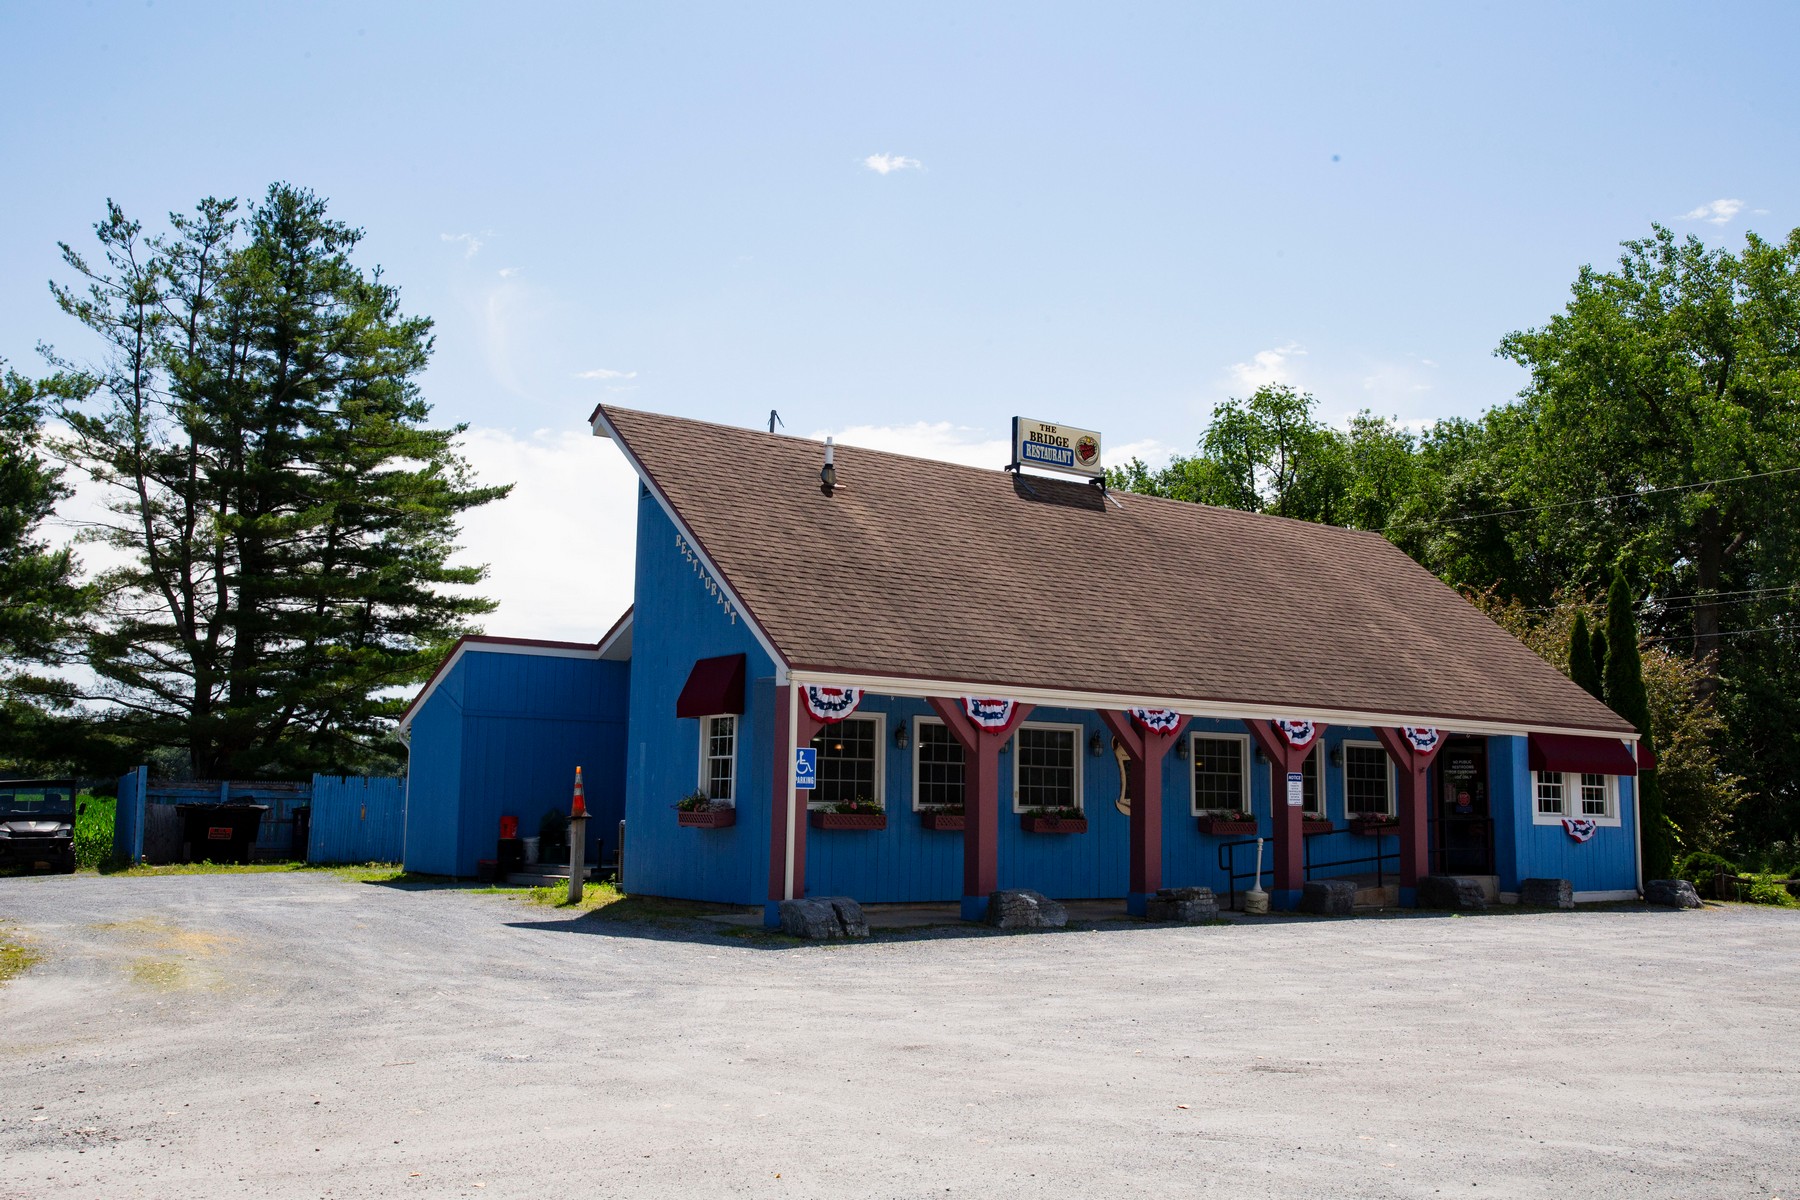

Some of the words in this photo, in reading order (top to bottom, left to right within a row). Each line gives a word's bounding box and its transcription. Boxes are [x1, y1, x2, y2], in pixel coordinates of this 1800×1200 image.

[1040, 424, 1057, 433] THE
[1030, 431, 1069, 447] BRIDGE
[1026, 443, 1072, 464] RESTAURANT
[675, 534, 737, 625] RESTAURANT
